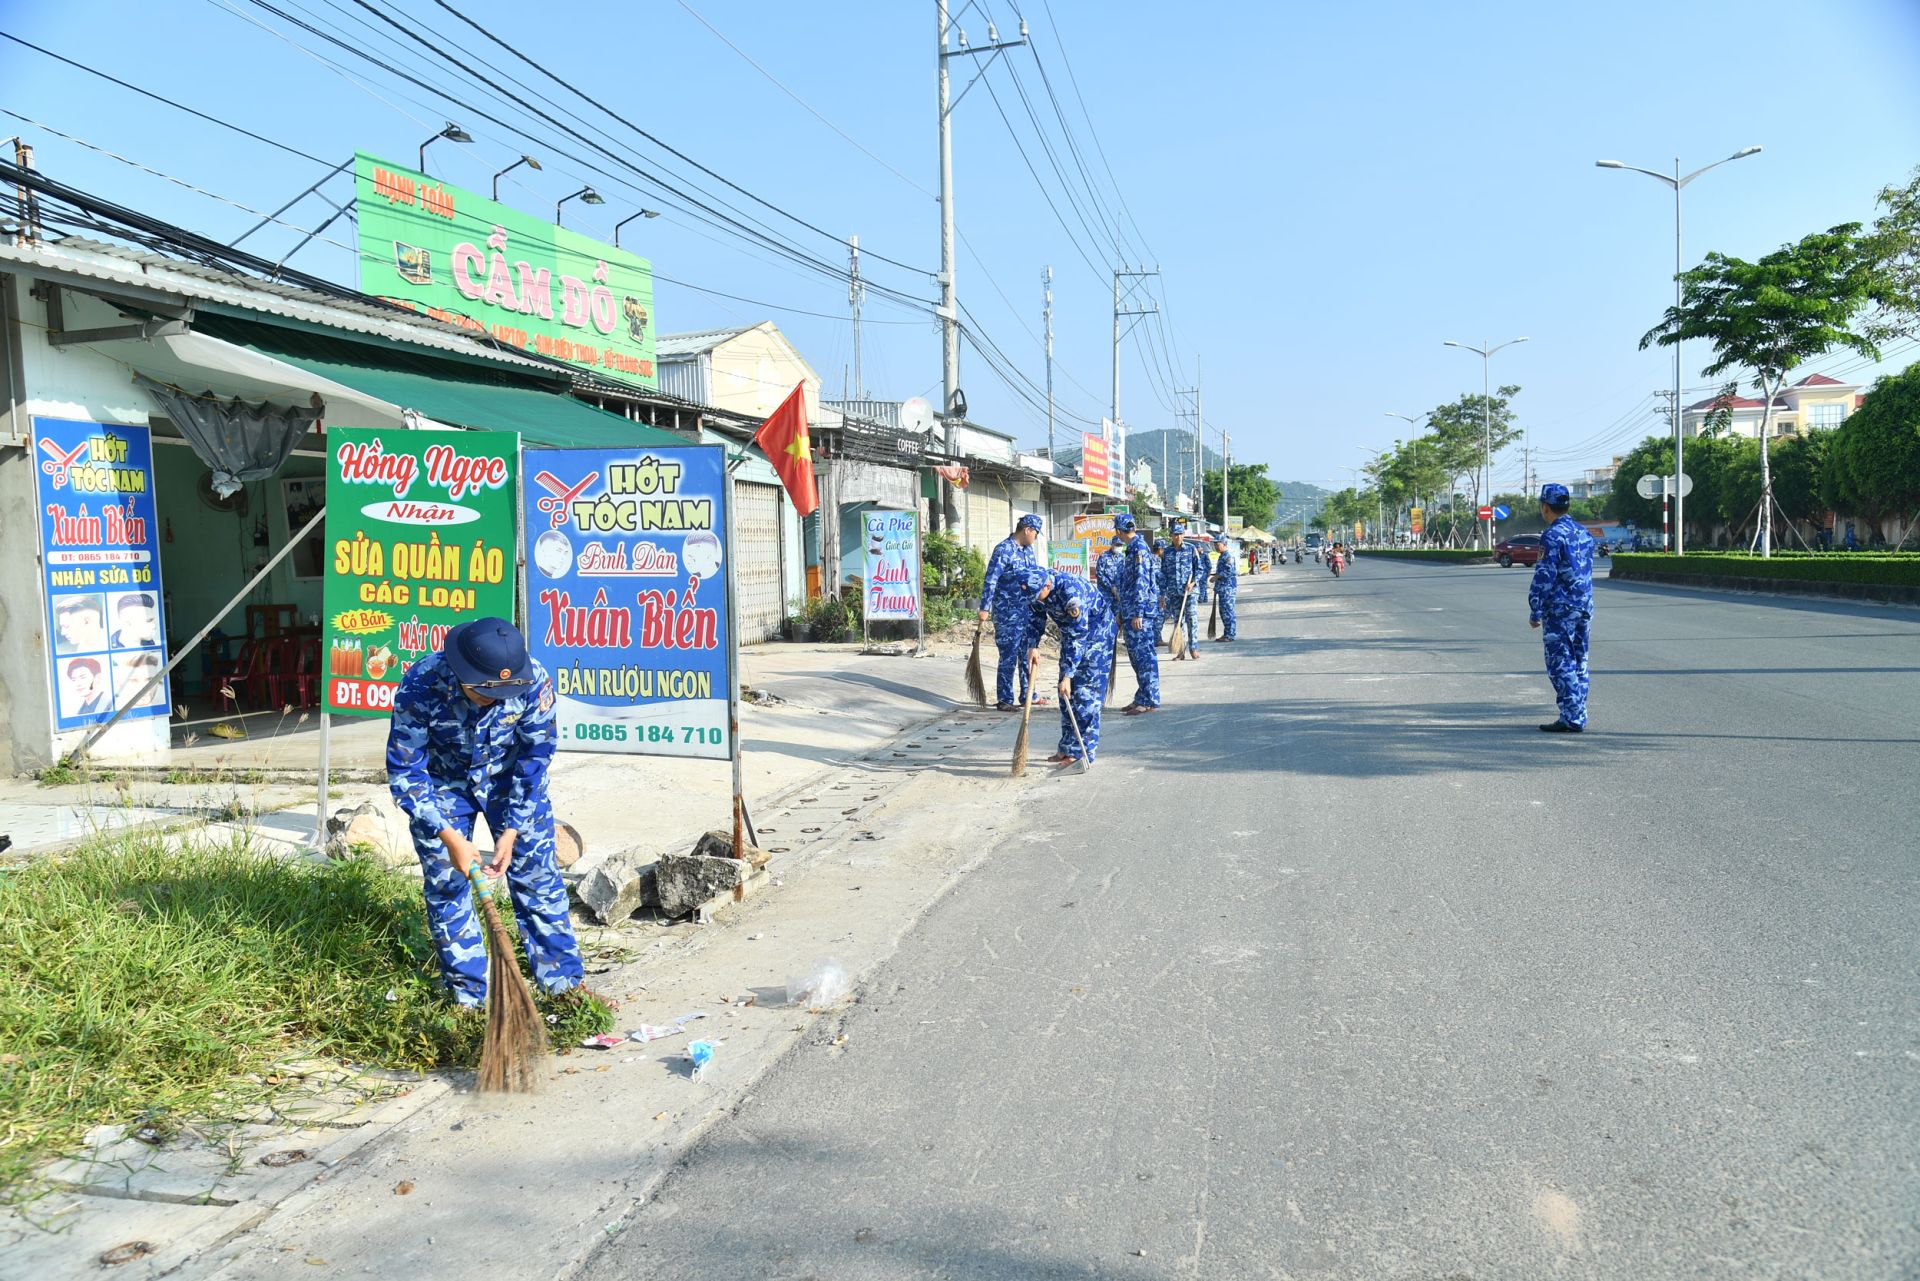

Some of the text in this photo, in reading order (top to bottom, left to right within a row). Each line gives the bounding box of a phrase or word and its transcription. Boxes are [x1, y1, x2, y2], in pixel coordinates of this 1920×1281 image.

[374, 167, 415, 206] MẠNH
[90, 432, 127, 463] HỚT
[70, 461, 146, 493] TÓC NAM
[337, 438, 509, 499] Hồng Ngọc
[609, 456, 680, 495] HỚT
[47, 496, 146, 544] Xuân Biển
[386, 502, 455, 522] Nhận
[573, 493, 711, 531] TÓC NAM
[867, 517, 913, 532] Cà Phê
[78, 553, 101, 561] 0865
[105, 553, 121, 561] 184
[123, 552, 140, 561] 710
[334, 530, 505, 584] SỬA QUẦN ÁO
[578, 543, 677, 571] Bình Dân
[873, 559, 909, 582] Linh
[51, 567, 95, 588] NHẬN
[99, 564, 130, 585] SỬA
[359, 580, 476, 612] CÁC LOẠI
[870, 586, 915, 615] Trang
[341, 611, 386, 629] Có Bán
[540, 576, 718, 650] Xuân Biển
[399, 614, 429, 658] MẬT
[556, 659, 711, 703] BÁN RƯỢU NGON
[575, 723, 627, 742] 0865
[635, 725, 674, 743] 184
[681, 726, 722, 745] 710
